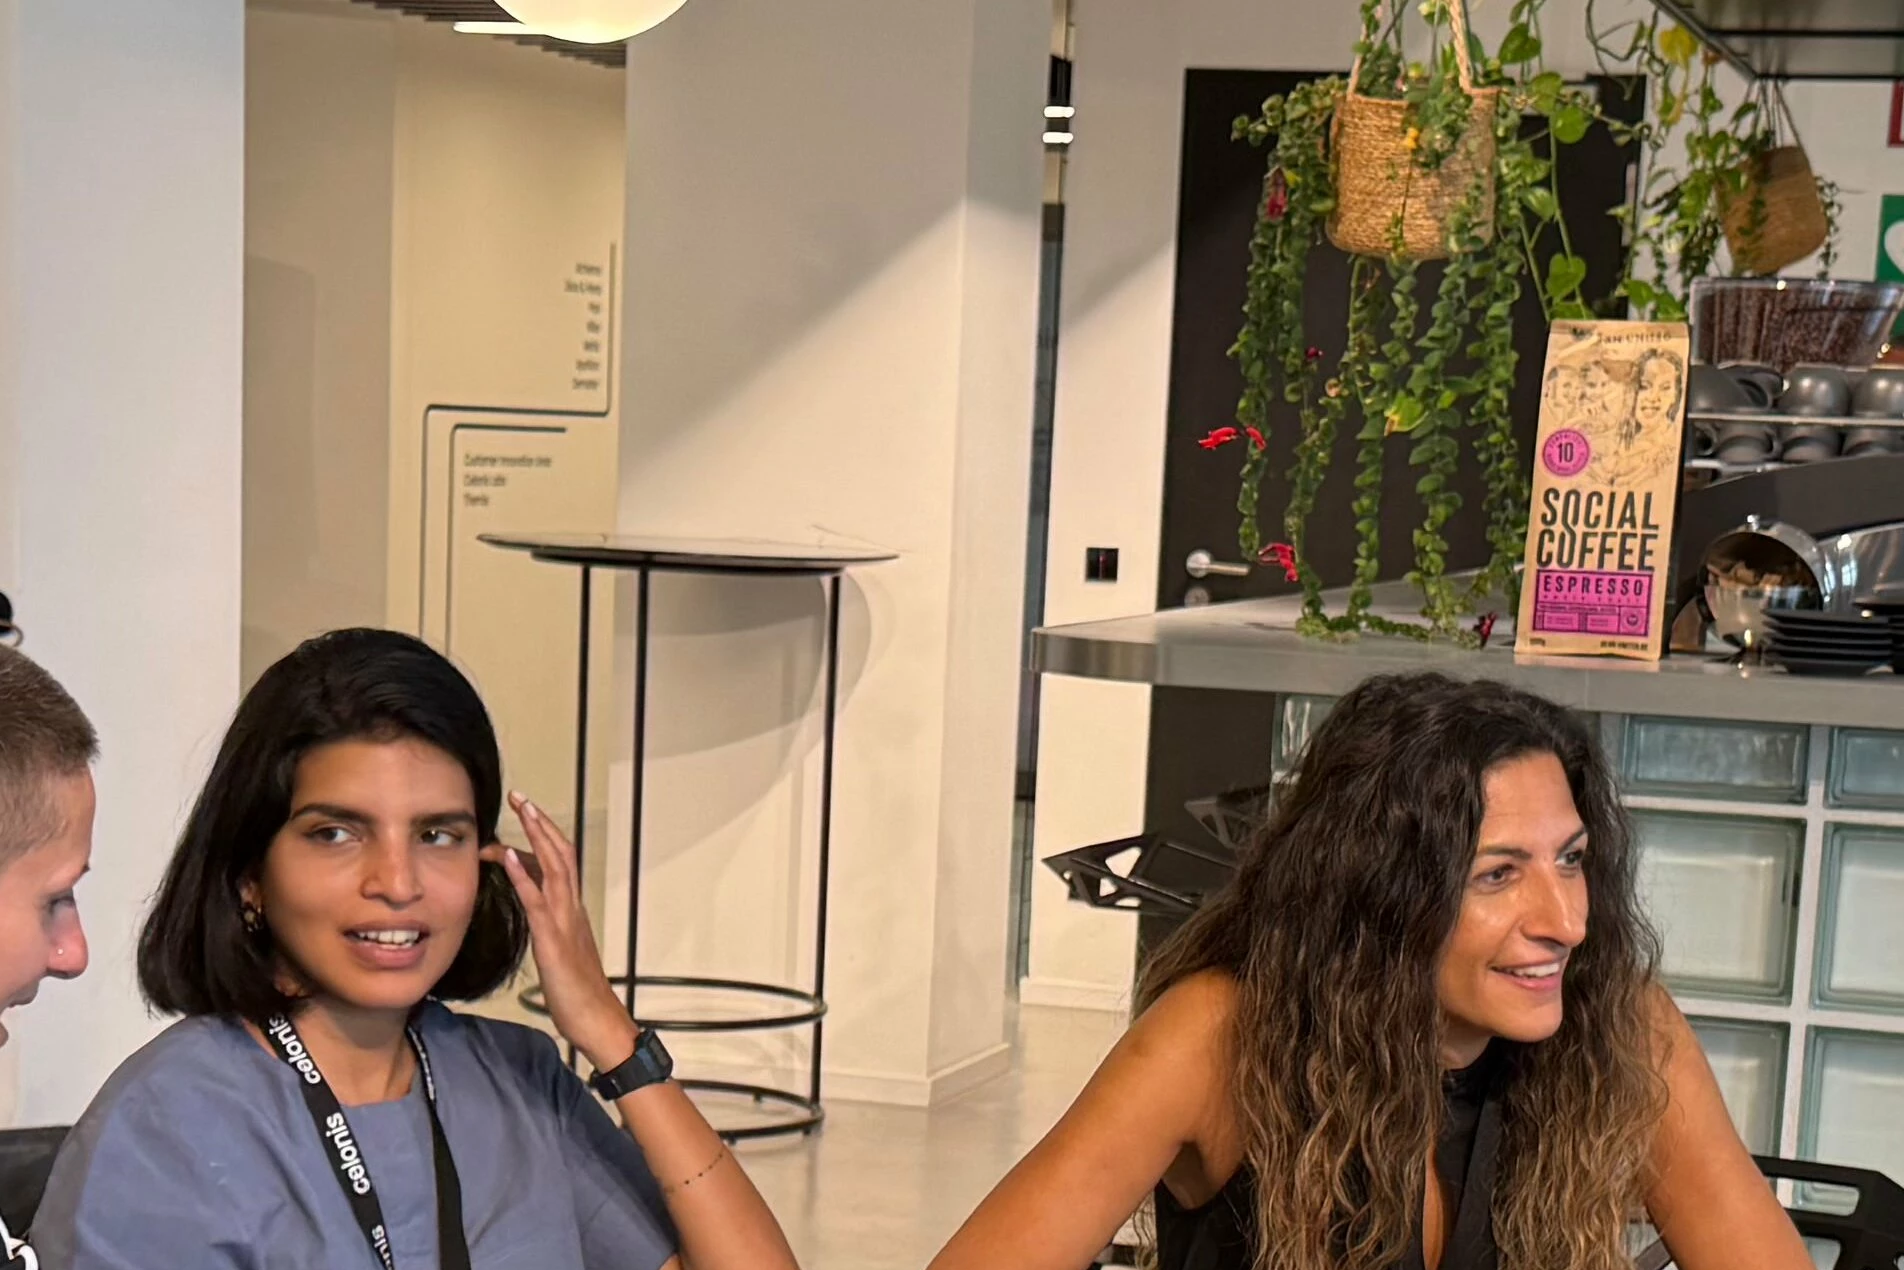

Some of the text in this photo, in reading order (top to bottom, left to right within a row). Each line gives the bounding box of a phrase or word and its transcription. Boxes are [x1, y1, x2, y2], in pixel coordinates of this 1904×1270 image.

[1558, 442, 1574, 463] 10
[1541, 487, 1659, 530] SOCIAL
[1536, 528, 1656, 572] COFFEE
[1543, 575, 1643, 596] ESPRESSO
[269, 1012, 322, 1085] celonis
[326, 1112, 371, 1195] celonis
